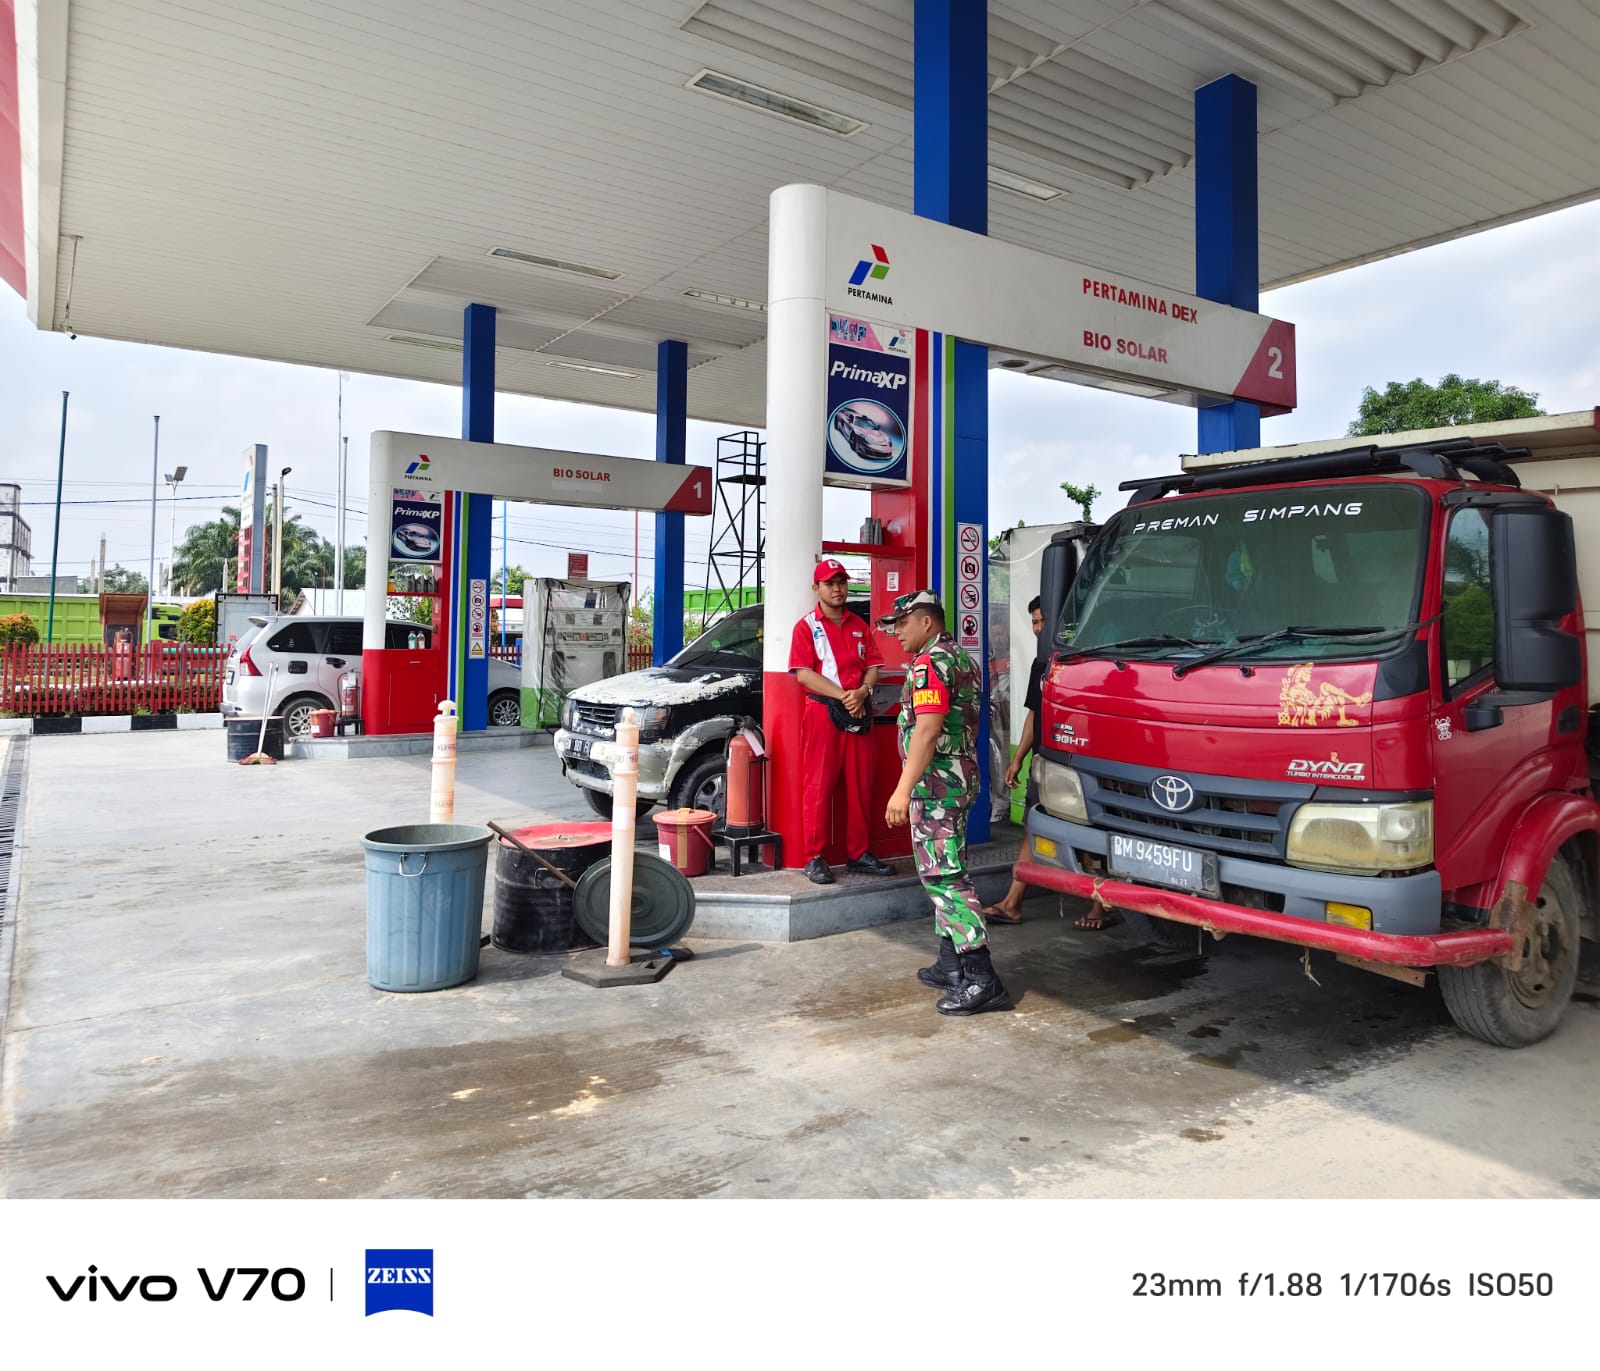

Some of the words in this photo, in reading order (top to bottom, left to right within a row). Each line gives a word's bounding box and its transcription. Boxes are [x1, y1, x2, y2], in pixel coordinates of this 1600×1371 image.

[847, 287, 893, 305] PERTAMINA
[1083, 278, 1167, 316] PERTAMINA
[1172, 303, 1198, 324] DEX
[1083, 330, 1111, 350] BIO
[1116, 338, 1168, 364] SOLAR
[830, 360, 907, 390] PrimaXP
[1268, 346, 1284, 380] 2
[553, 467, 573, 479] BIO
[575, 469, 611, 482] SOLAR
[693, 481, 702, 499] 1
[394, 507, 441, 520] PrimaXP
[1132, 513, 1220, 535] PREMAN
[1242, 502, 1363, 523] SIMPANG
[1287, 759, 1365, 775] DYNA
